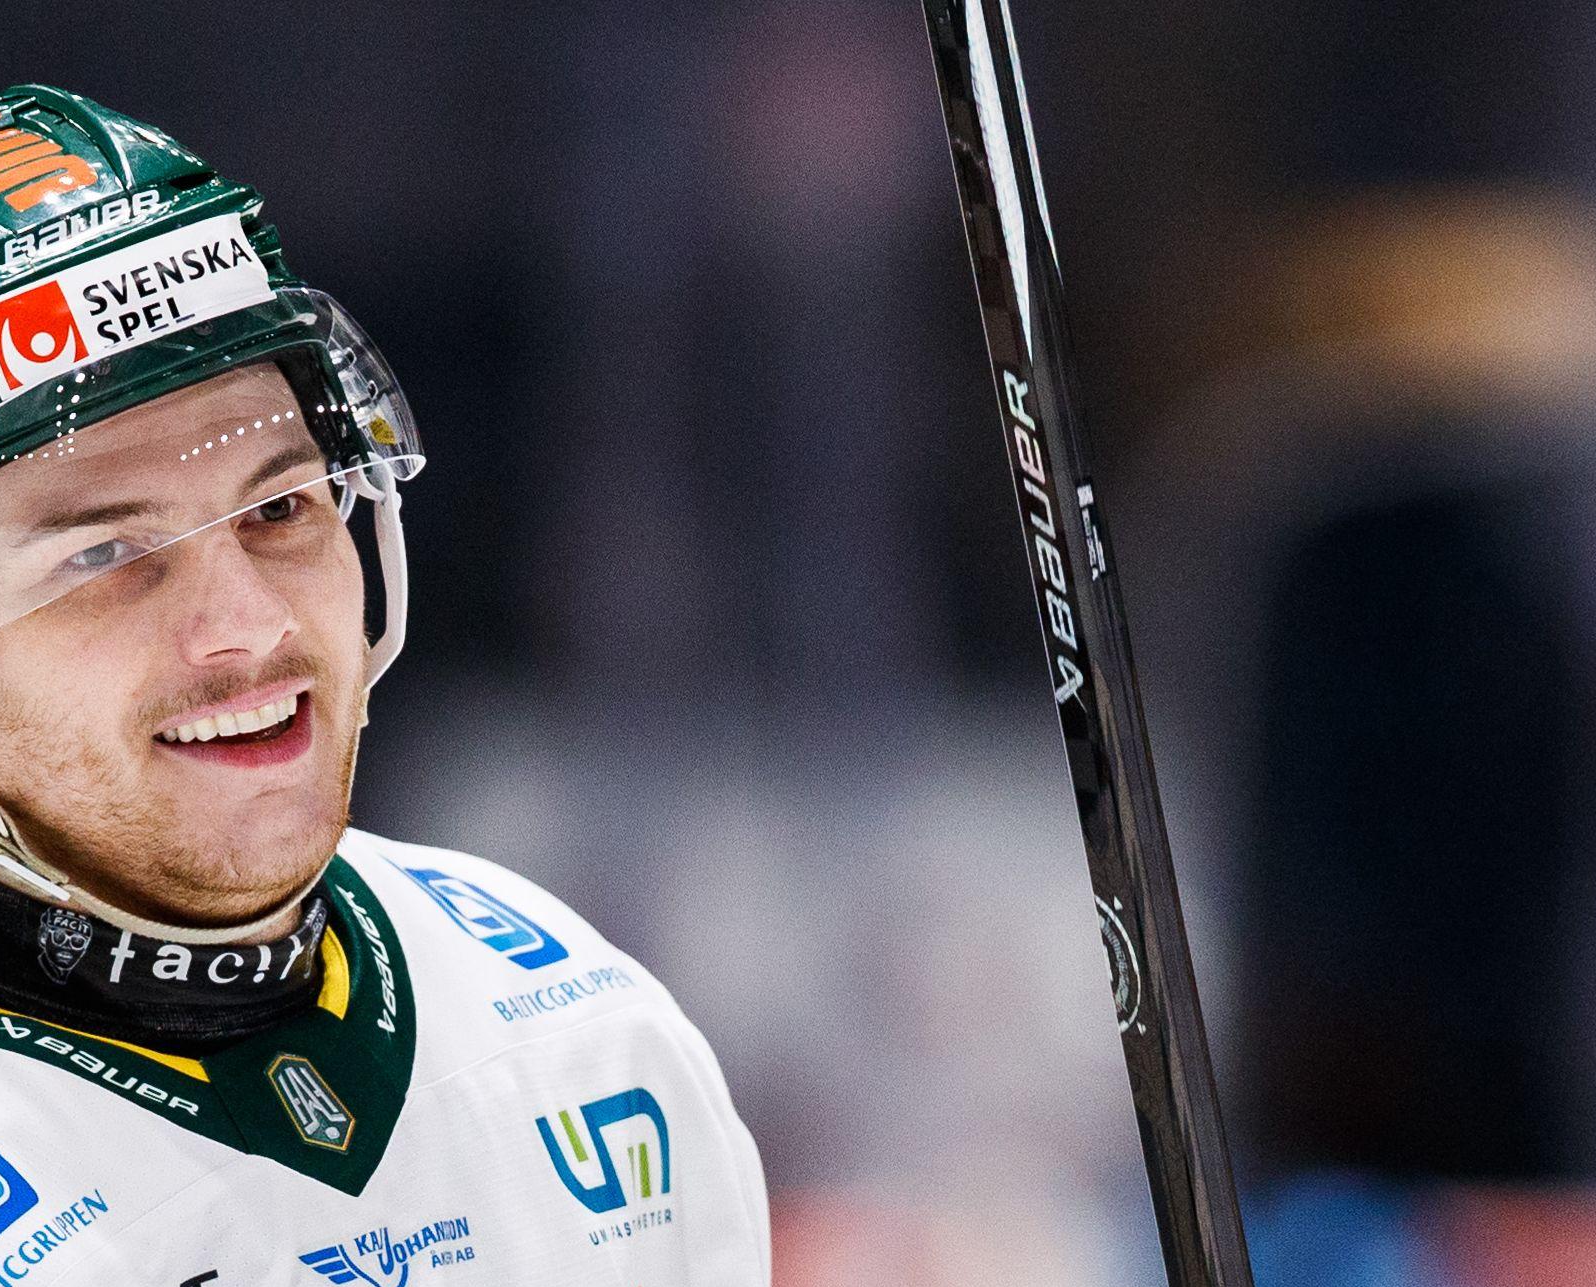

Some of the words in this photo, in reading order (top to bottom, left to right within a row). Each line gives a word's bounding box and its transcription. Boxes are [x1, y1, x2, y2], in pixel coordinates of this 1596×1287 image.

[83, 235, 252, 316] SVENSKA
[97, 297, 195, 346] SPEL
[54, 917, 89, 933] FACIT
[455, 1246, 475, 1263] AB
